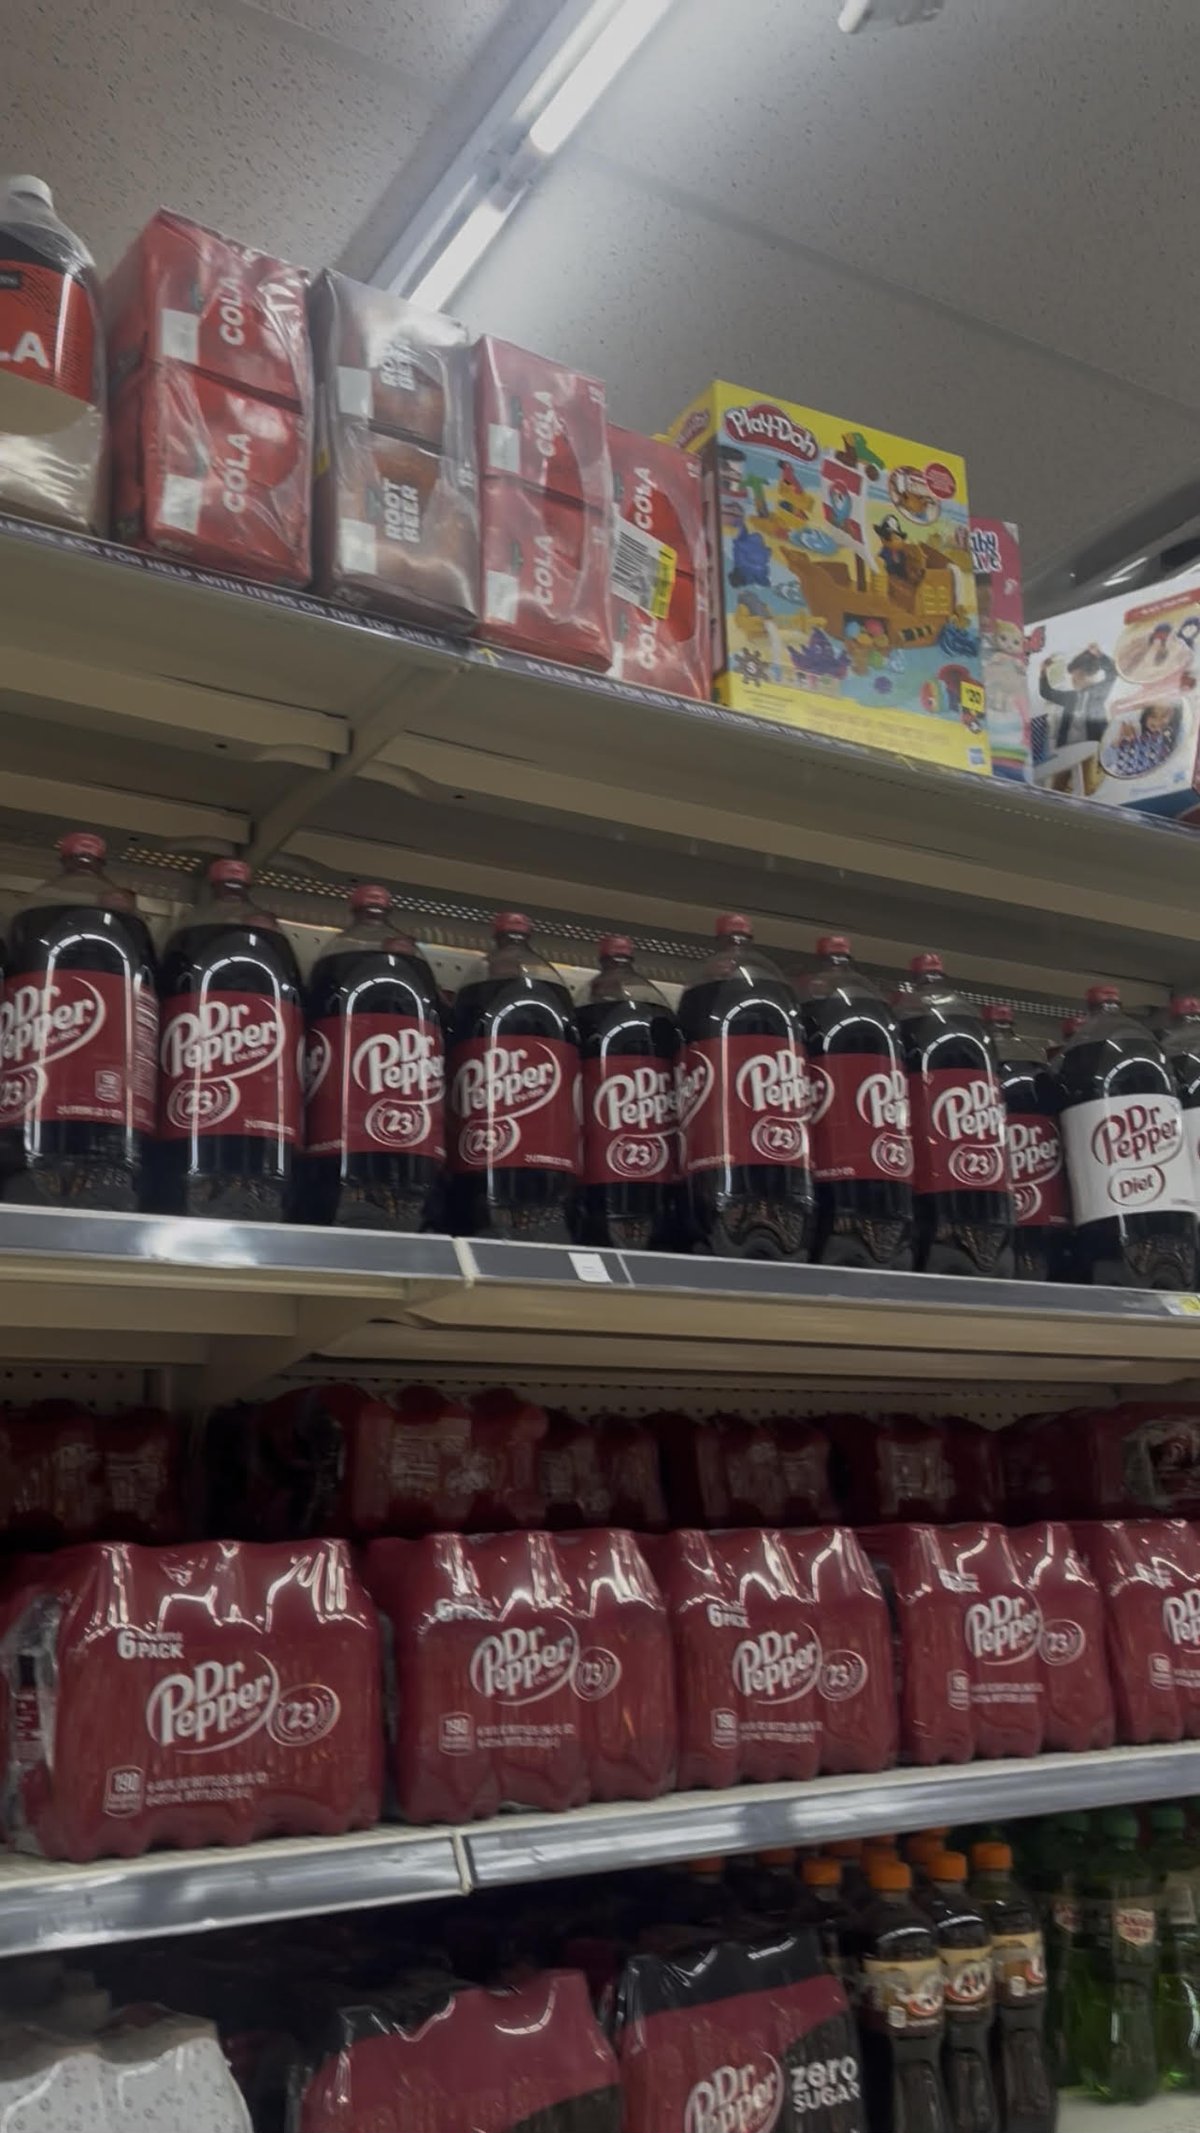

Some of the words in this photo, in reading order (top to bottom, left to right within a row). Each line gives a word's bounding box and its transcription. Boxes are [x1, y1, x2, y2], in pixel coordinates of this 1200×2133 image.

[218, 275, 246, 346] COLA
[533, 391, 557, 457] COLA
[724, 408, 817, 459] Play-Doh
[223, 432, 253, 513] COLA
[383, 477, 403, 540] ROOT
[401, 483, 421, 544] BEER
[633, 466, 660, 531] COLA
[0, 517, 57, 542] LEASE
[60, 534, 102, 555] ASK
[103, 548, 144, 568] FOR
[146, 558, 193, 578] HELP
[196, 571, 245, 594] WITH
[245, 583, 299, 609] ITEMS
[300, 600, 327, 616] ON
[328, 606, 360, 627] THE
[363, 616, 396, 635] TOP
[398, 626, 447, 648] SHELF
[533, 535, 554, 606] COLA
[637, 619, 658, 671] COL
[526, 660, 582, 683] PLEASE
[14, 985, 62, 1027] Dr
[200, 1000, 249, 1038] Dr
[162, 1012, 278, 1079] Pepper
[398, 1027, 435, 1063] Dr
[483, 1047, 529, 1083] Dr
[633, 1066, 671, 1099] Dr
[775, 1048, 806, 1082] Dr
[185, 1087, 214, 1116] 23
[453, 1058, 555, 1119] Pepper
[856, 1073, 910, 1130] Pep
[889, 1068, 908, 1101] D
[968, 1080, 1000, 1111] Dr
[385, 1109, 413, 1135] 23
[770, 1125, 795, 1150] 23
[1124, 1104, 1161, 1136] Dr
[474, 1128, 498, 1151] 23
[625, 1143, 651, 1166] 23
[1006, 1123, 1043, 1154] Dr
[1091, 1114, 1178, 1167] Pepper
[966, 1152, 990, 1175] 23
[1010, 1138, 1060, 1180] pper
[1118, 1173, 1155, 1199] Diet
[706, 1603, 723, 1628] 6
[987, 1595, 1027, 1627] Dr
[1183, 1588, 1200, 1617] D
[1162, 1597, 1200, 1647] Pep
[117, 1630, 137, 1660] 6
[138, 1642, 185, 1660] PACK
[501, 1626, 546, 1662] Dr
[757, 1630, 799, 1662] Dr
[193, 1661, 245, 1707] Dr
[470, 1635, 575, 1698] Pepper
[732, 1640, 818, 1697] Pepper
[147, 1673, 271, 1748] Pepper
[286, 1702, 317, 1730] 23
[712, 2064, 755, 2101] Dr
[789, 2055, 859, 2093] zero
[793, 2081, 862, 2115] SUGAR
